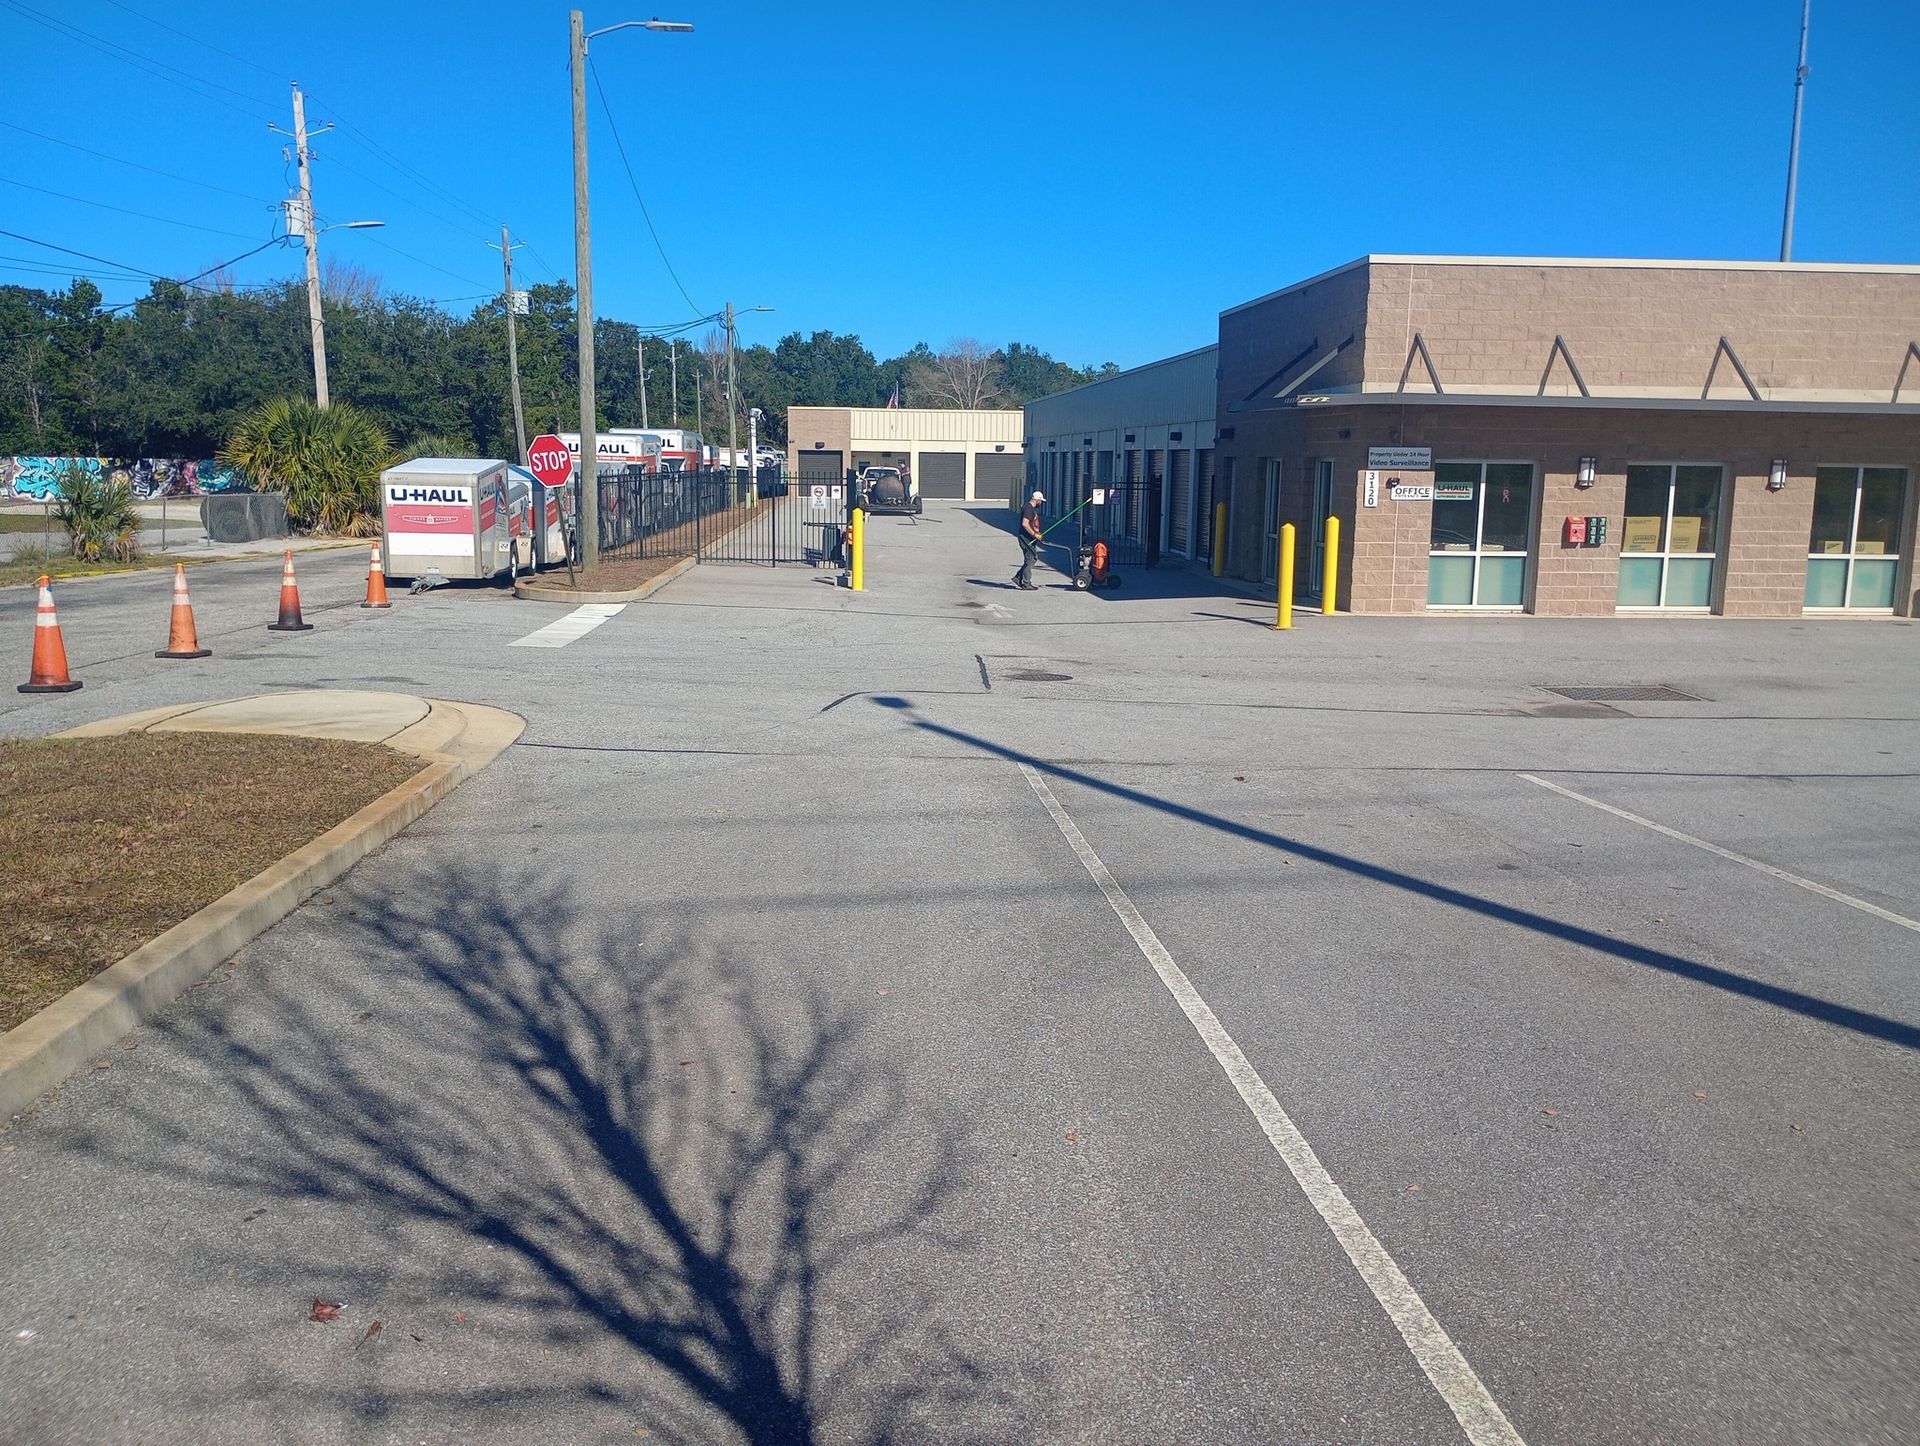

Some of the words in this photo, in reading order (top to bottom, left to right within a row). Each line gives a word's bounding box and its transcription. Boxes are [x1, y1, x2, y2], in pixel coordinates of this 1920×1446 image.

[531, 450, 568, 472] STOP
[390, 488, 468, 502] U-HAUL
[1395, 487, 1431, 495] OFFICE
